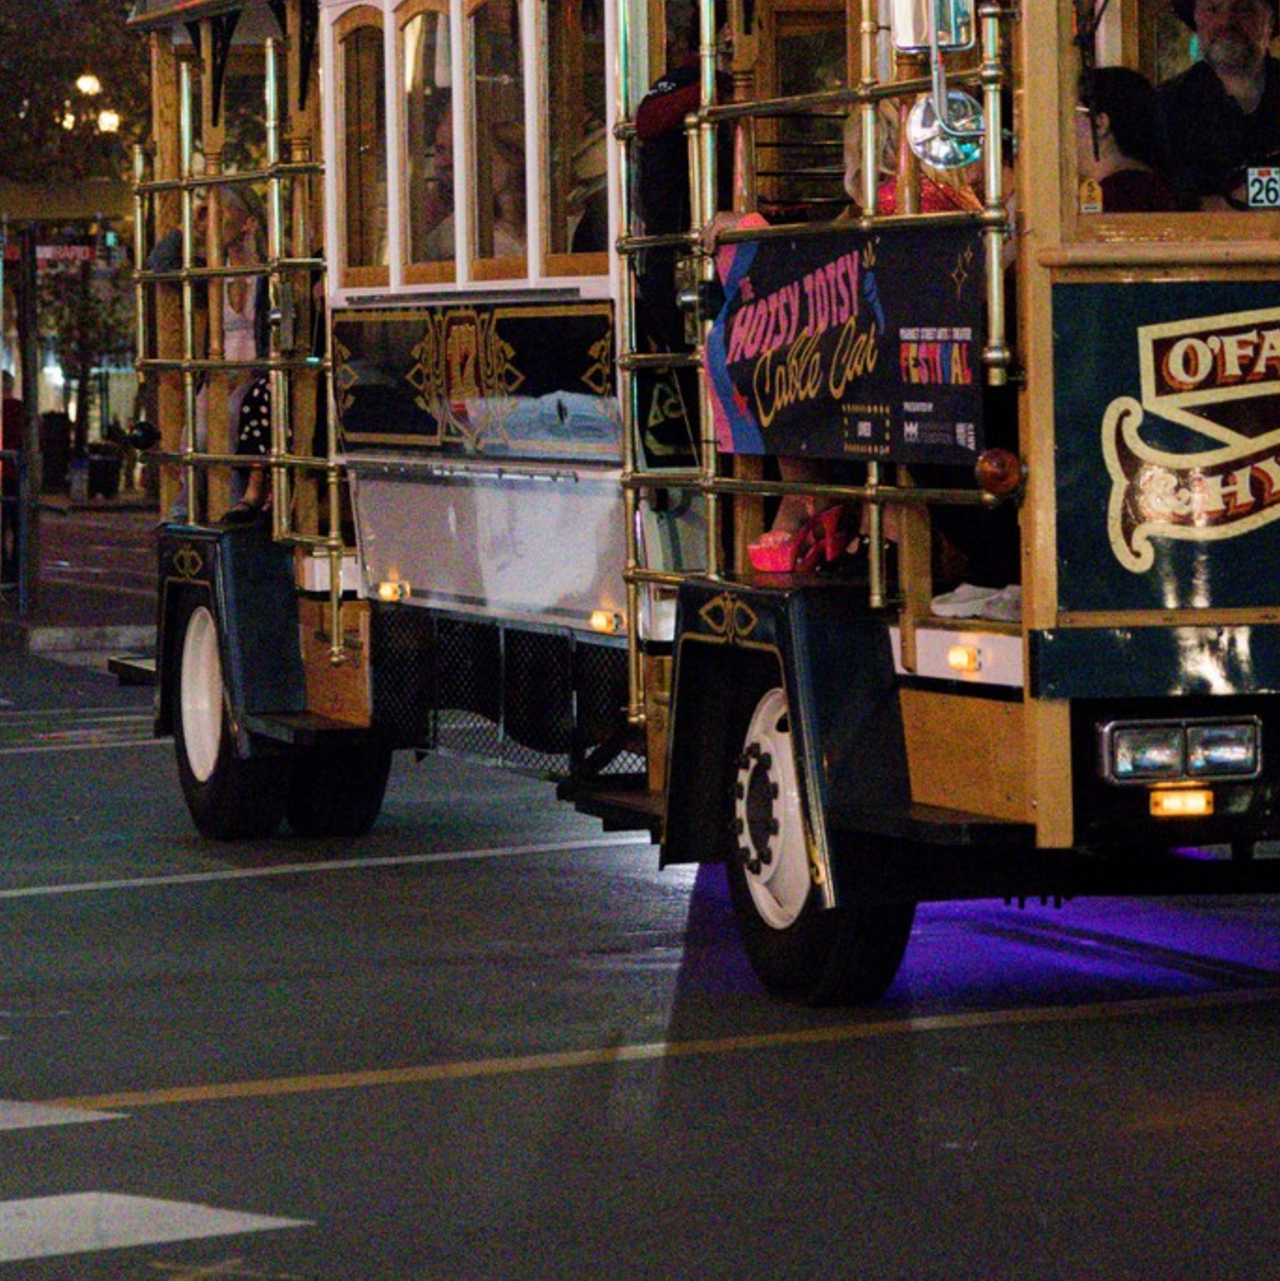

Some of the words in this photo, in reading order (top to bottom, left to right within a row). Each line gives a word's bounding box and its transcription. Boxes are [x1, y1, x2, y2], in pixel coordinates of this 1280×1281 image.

[1250, 177, 1280, 205] 26
[726, 280, 800, 365] HOTSY
[753, 326, 823, 428] Cable
[829, 314, 878, 400] Car
[900, 342, 972, 385] FESTIVAL
[1142, 465, 1193, 517] &
